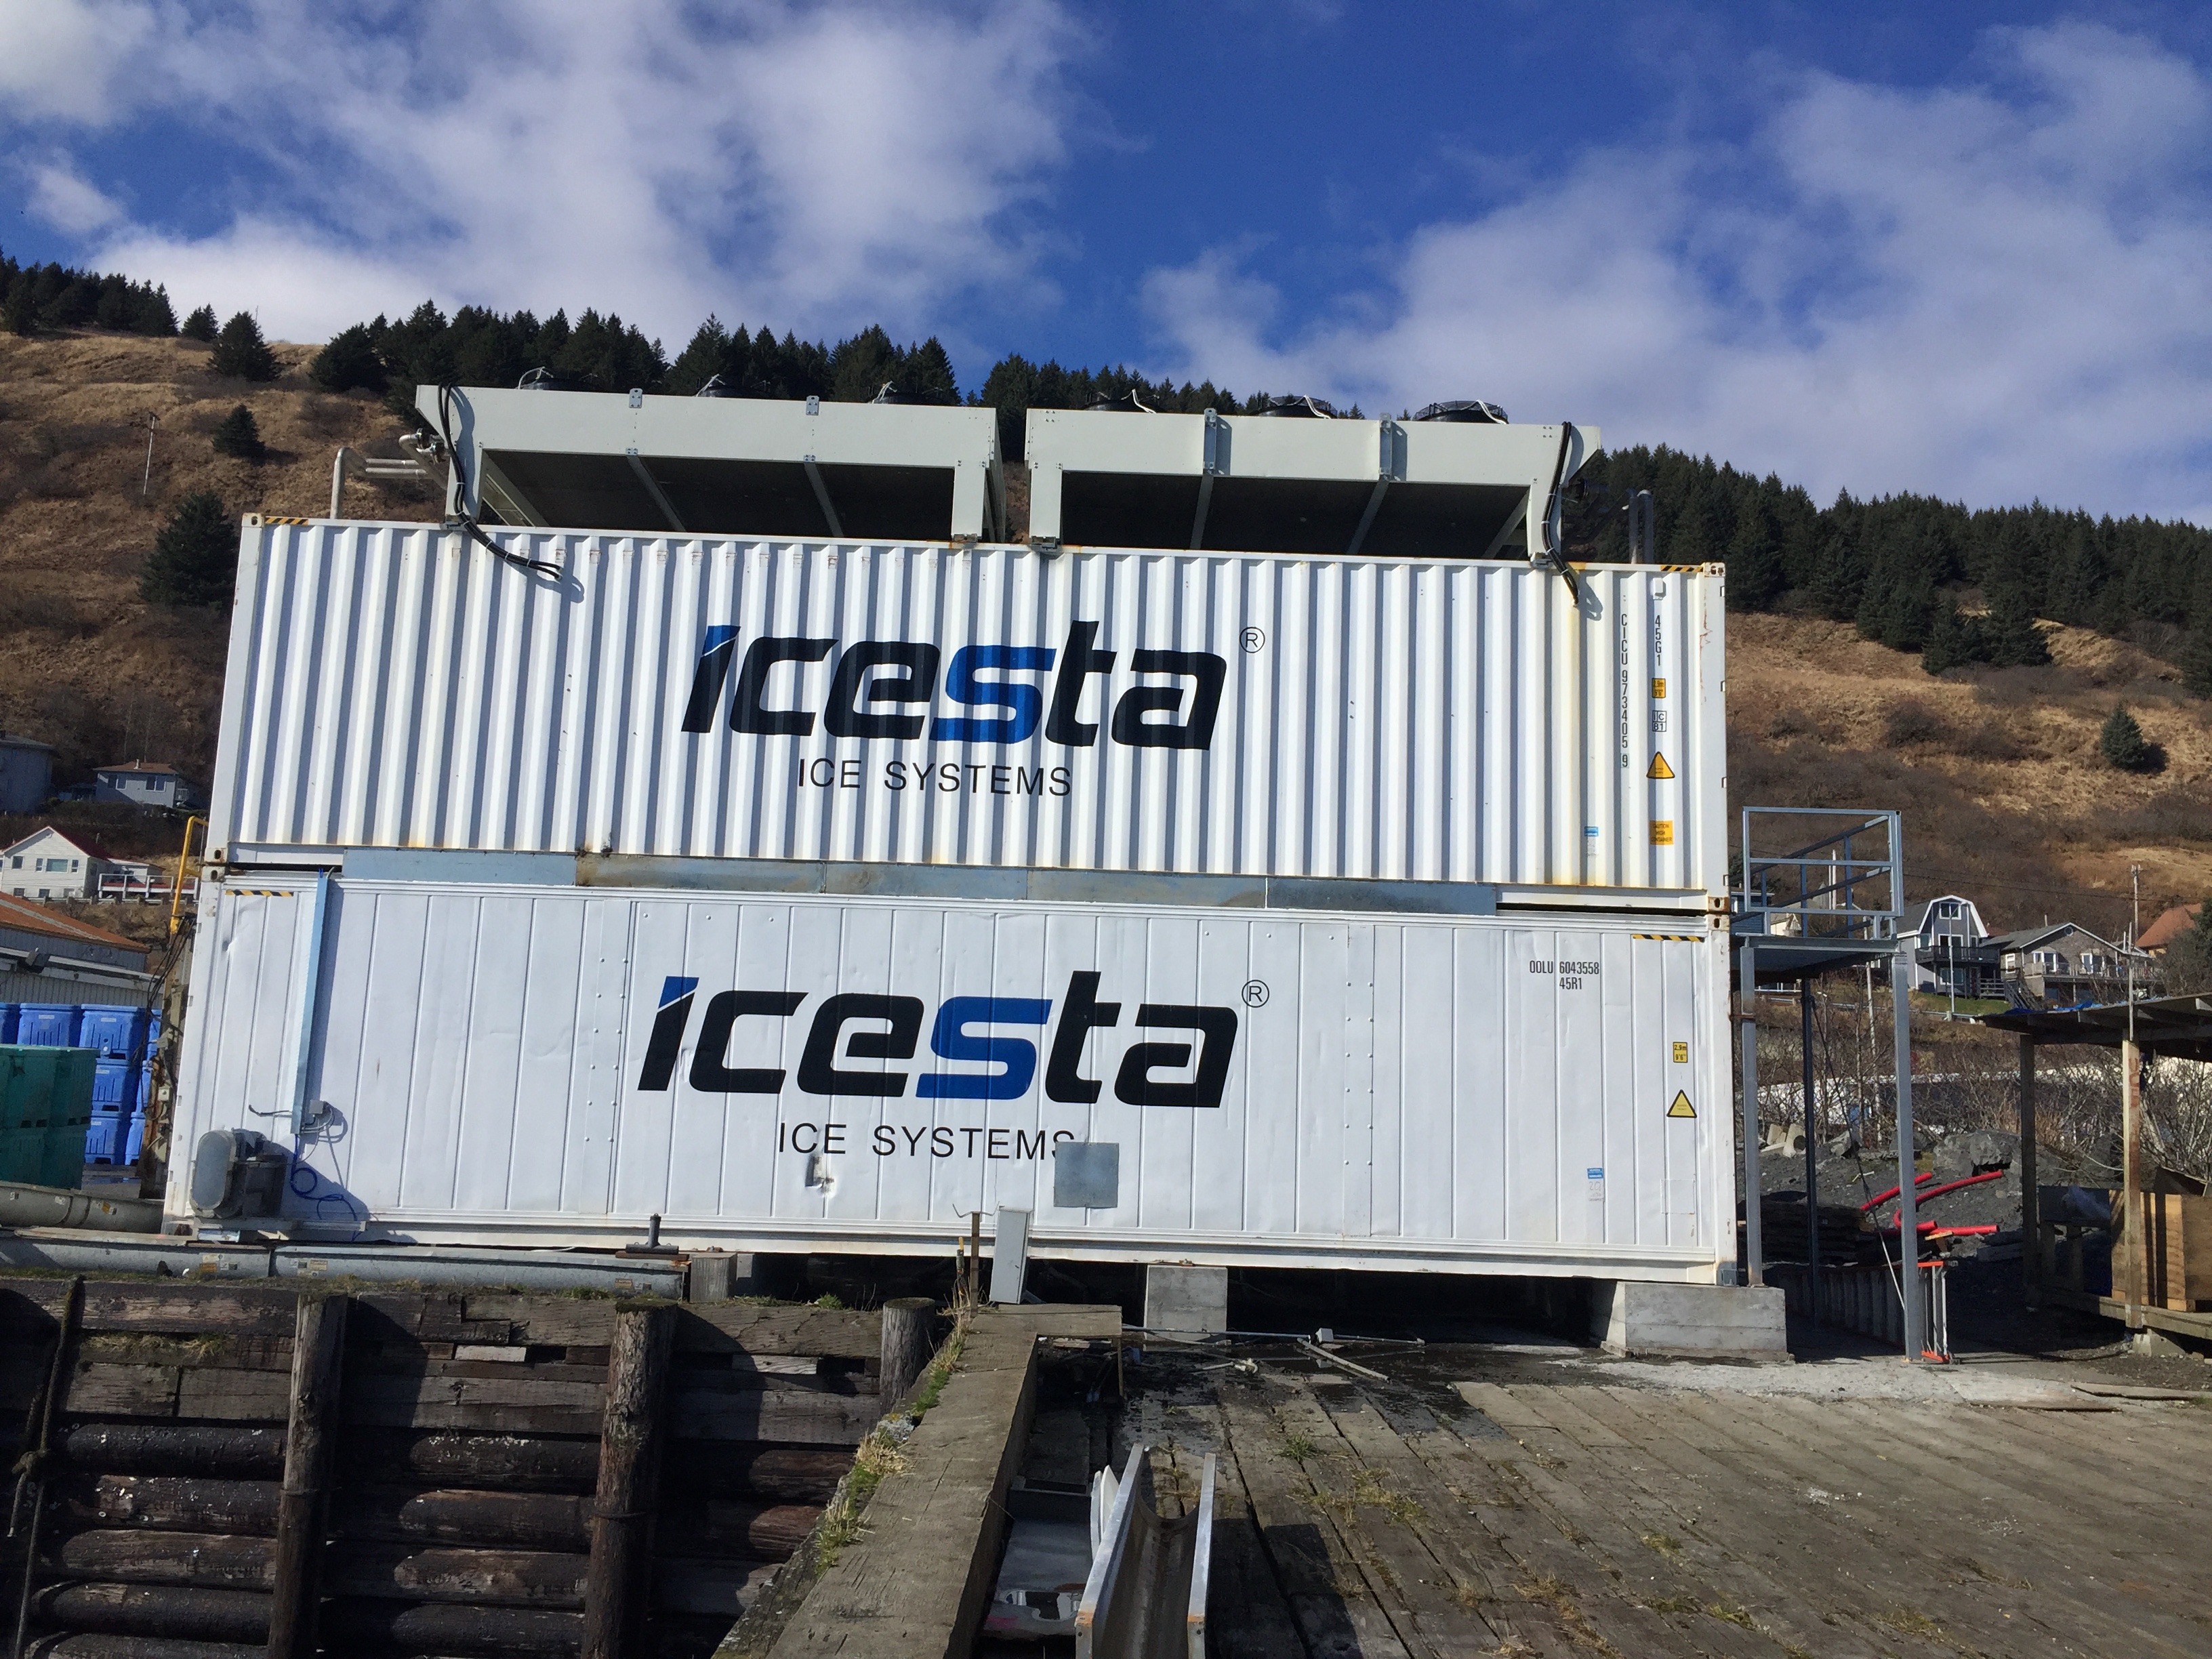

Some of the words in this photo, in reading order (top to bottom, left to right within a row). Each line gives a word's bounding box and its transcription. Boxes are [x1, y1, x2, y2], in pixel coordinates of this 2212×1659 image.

[681, 620, 1227, 750] icesta
[799, 758, 861, 789] ICE
[885, 761, 1071, 796] SYSTEMS
[1559, 961, 1599, 975] 6043558
[1559, 977, 1582, 989] 45R1
[638, 971, 1238, 1107] icesta
[780, 1123, 846, 1153] ICE
